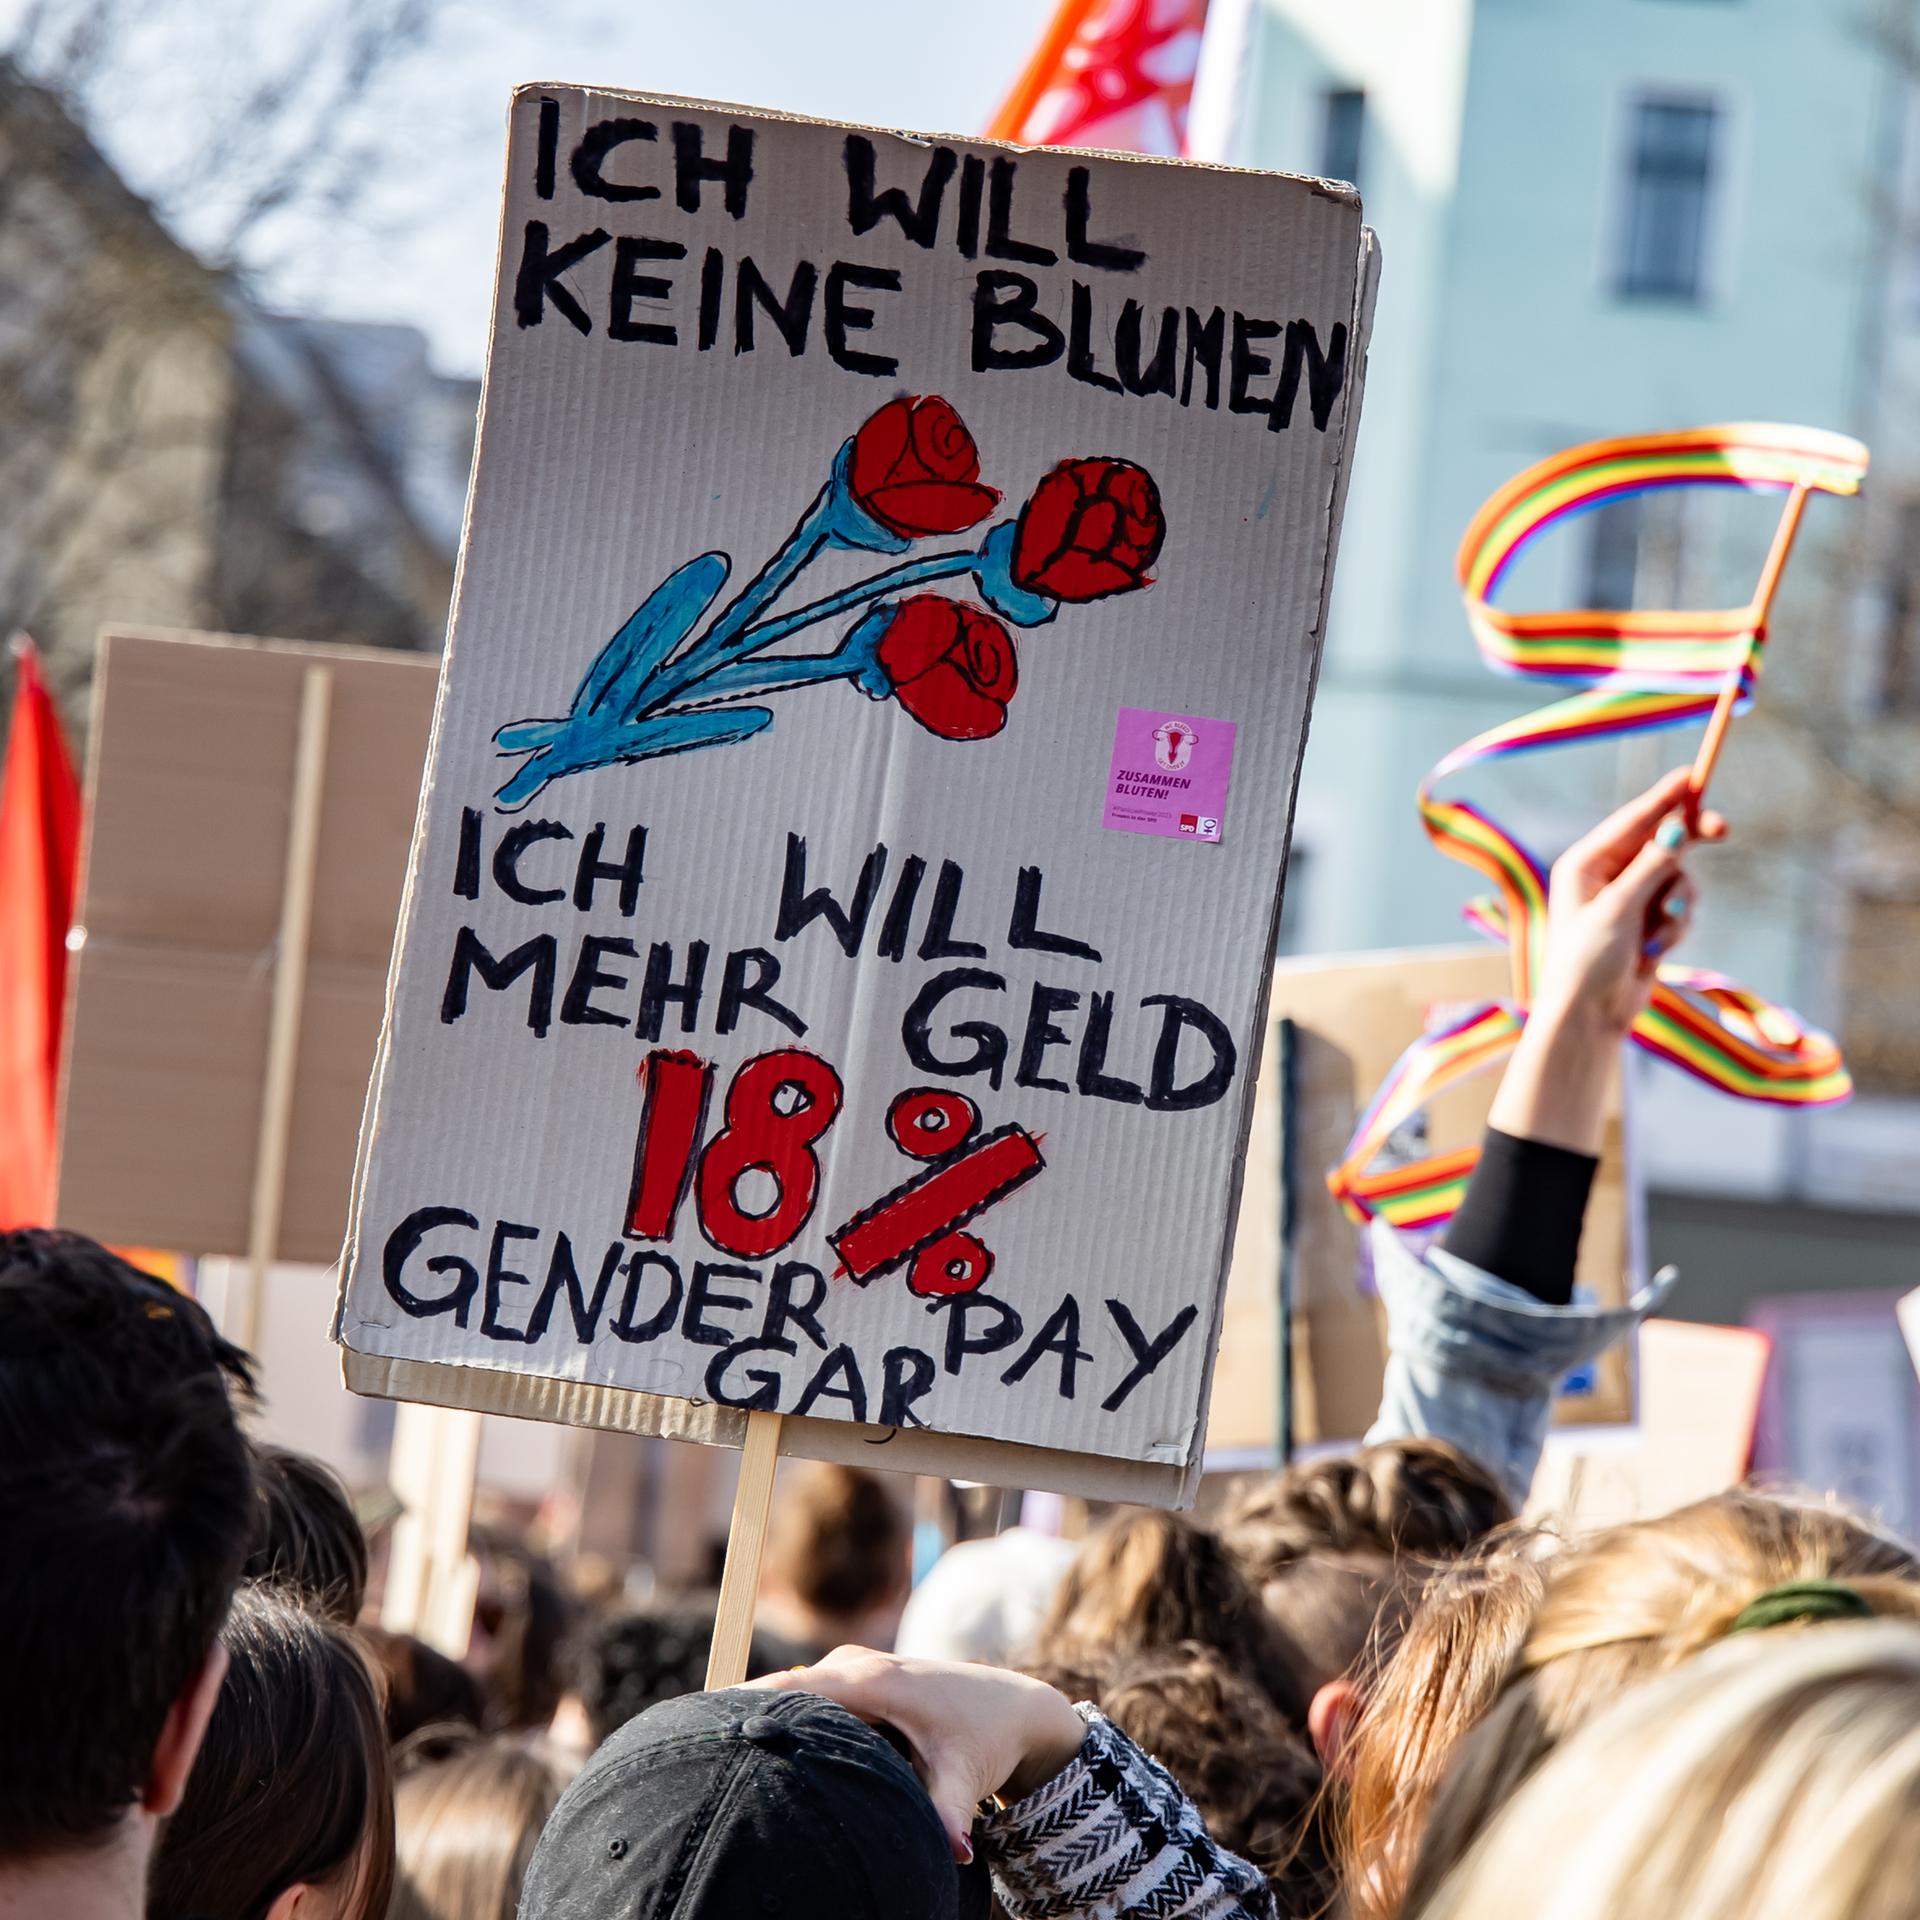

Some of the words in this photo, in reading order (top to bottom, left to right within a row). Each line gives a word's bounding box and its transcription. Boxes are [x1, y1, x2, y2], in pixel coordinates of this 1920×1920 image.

[527, 96, 755, 219] ICH
[845, 133, 1147, 271] WILL
[514, 220, 902, 377] KEINE
[971, 269, 1348, 432] BLUMEN
[1115, 783, 1169, 800] BLUTEN!
[1117, 769, 1191, 789] ZUSAMMEN
[1179, 823, 1195, 833] SPD
[453, 806, 649, 917] ICH
[774, 832, 1102, 963] WILL
[441, 926, 808, 1043] MEHR
[901, 967, 1237, 1111] GELD
[383, 1206, 828, 1350] GENDER
[925, 1293, 1198, 1412] PAY
